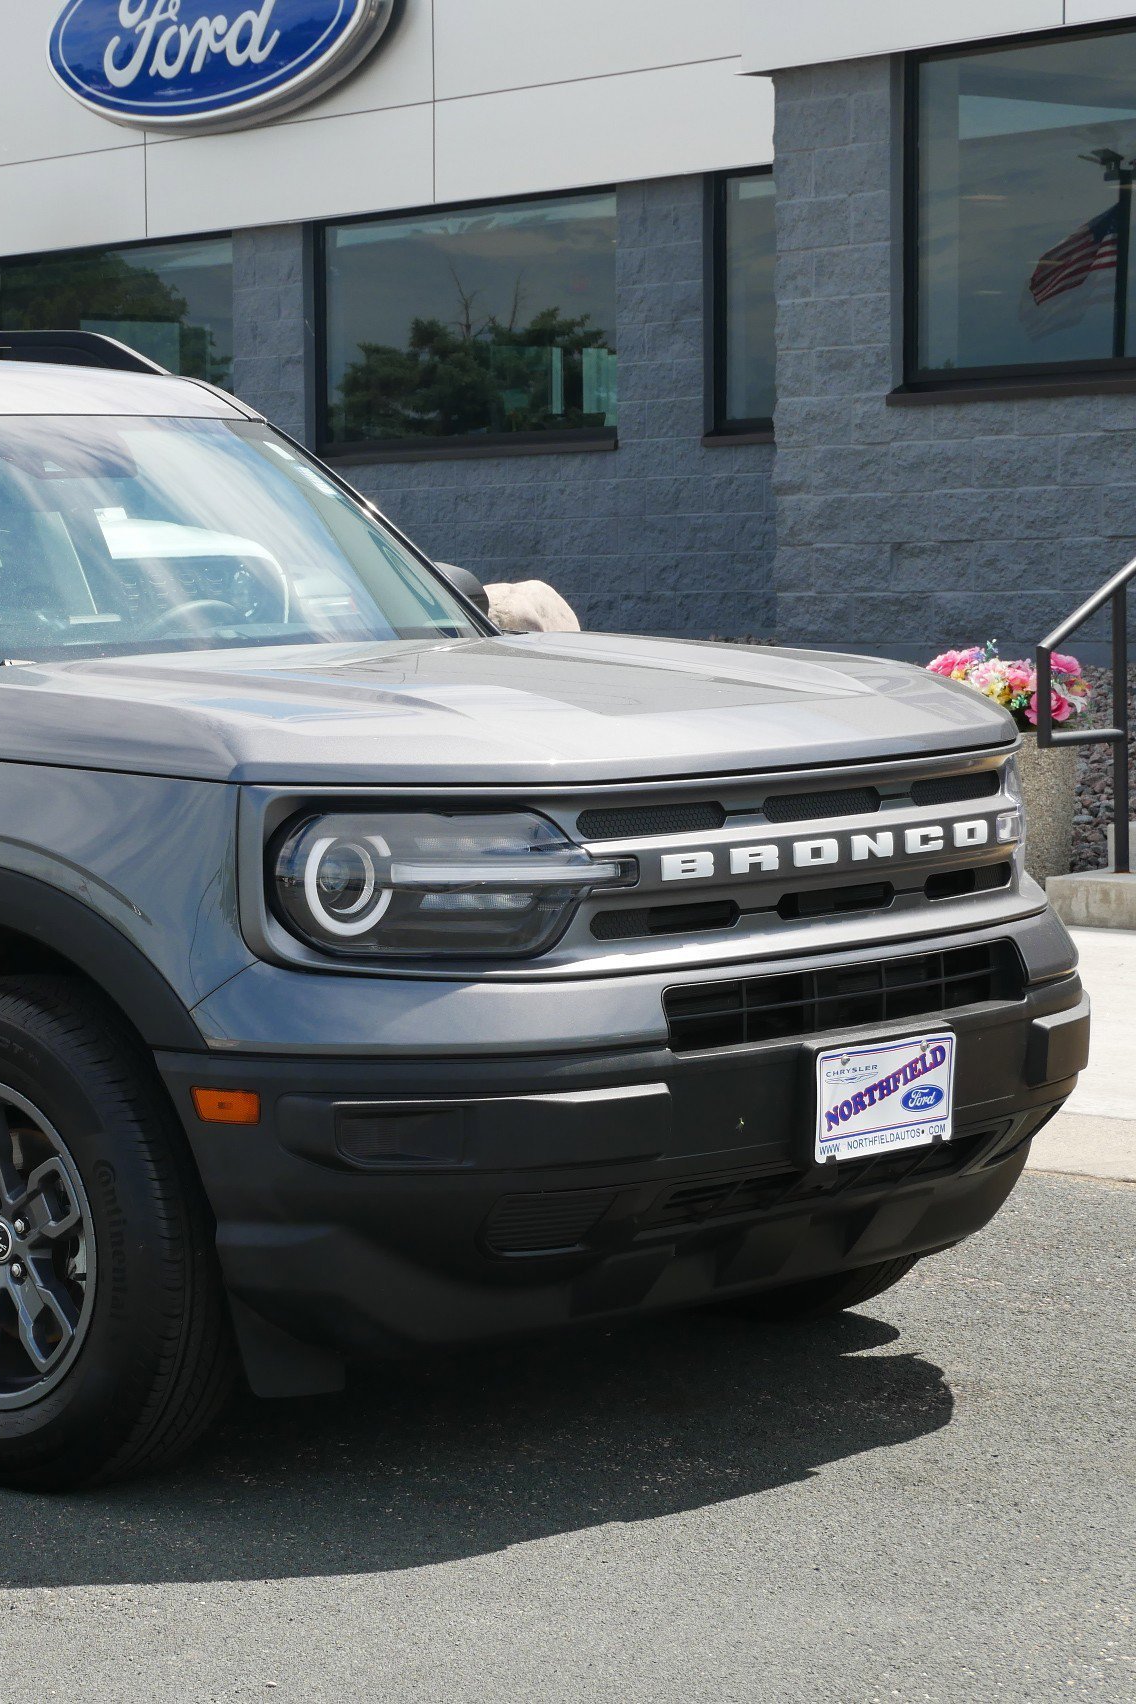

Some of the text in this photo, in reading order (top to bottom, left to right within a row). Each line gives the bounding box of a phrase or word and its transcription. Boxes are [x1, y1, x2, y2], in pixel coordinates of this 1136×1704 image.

[103, 0, 280, 88] Ford
[660, 819, 988, 882] BRONCO
[824, 1045, 947, 1132] NORTHFIELD
[825, 1064, 878, 1078] CHRYSLER
[908, 1089, 935, 1108] Ford
